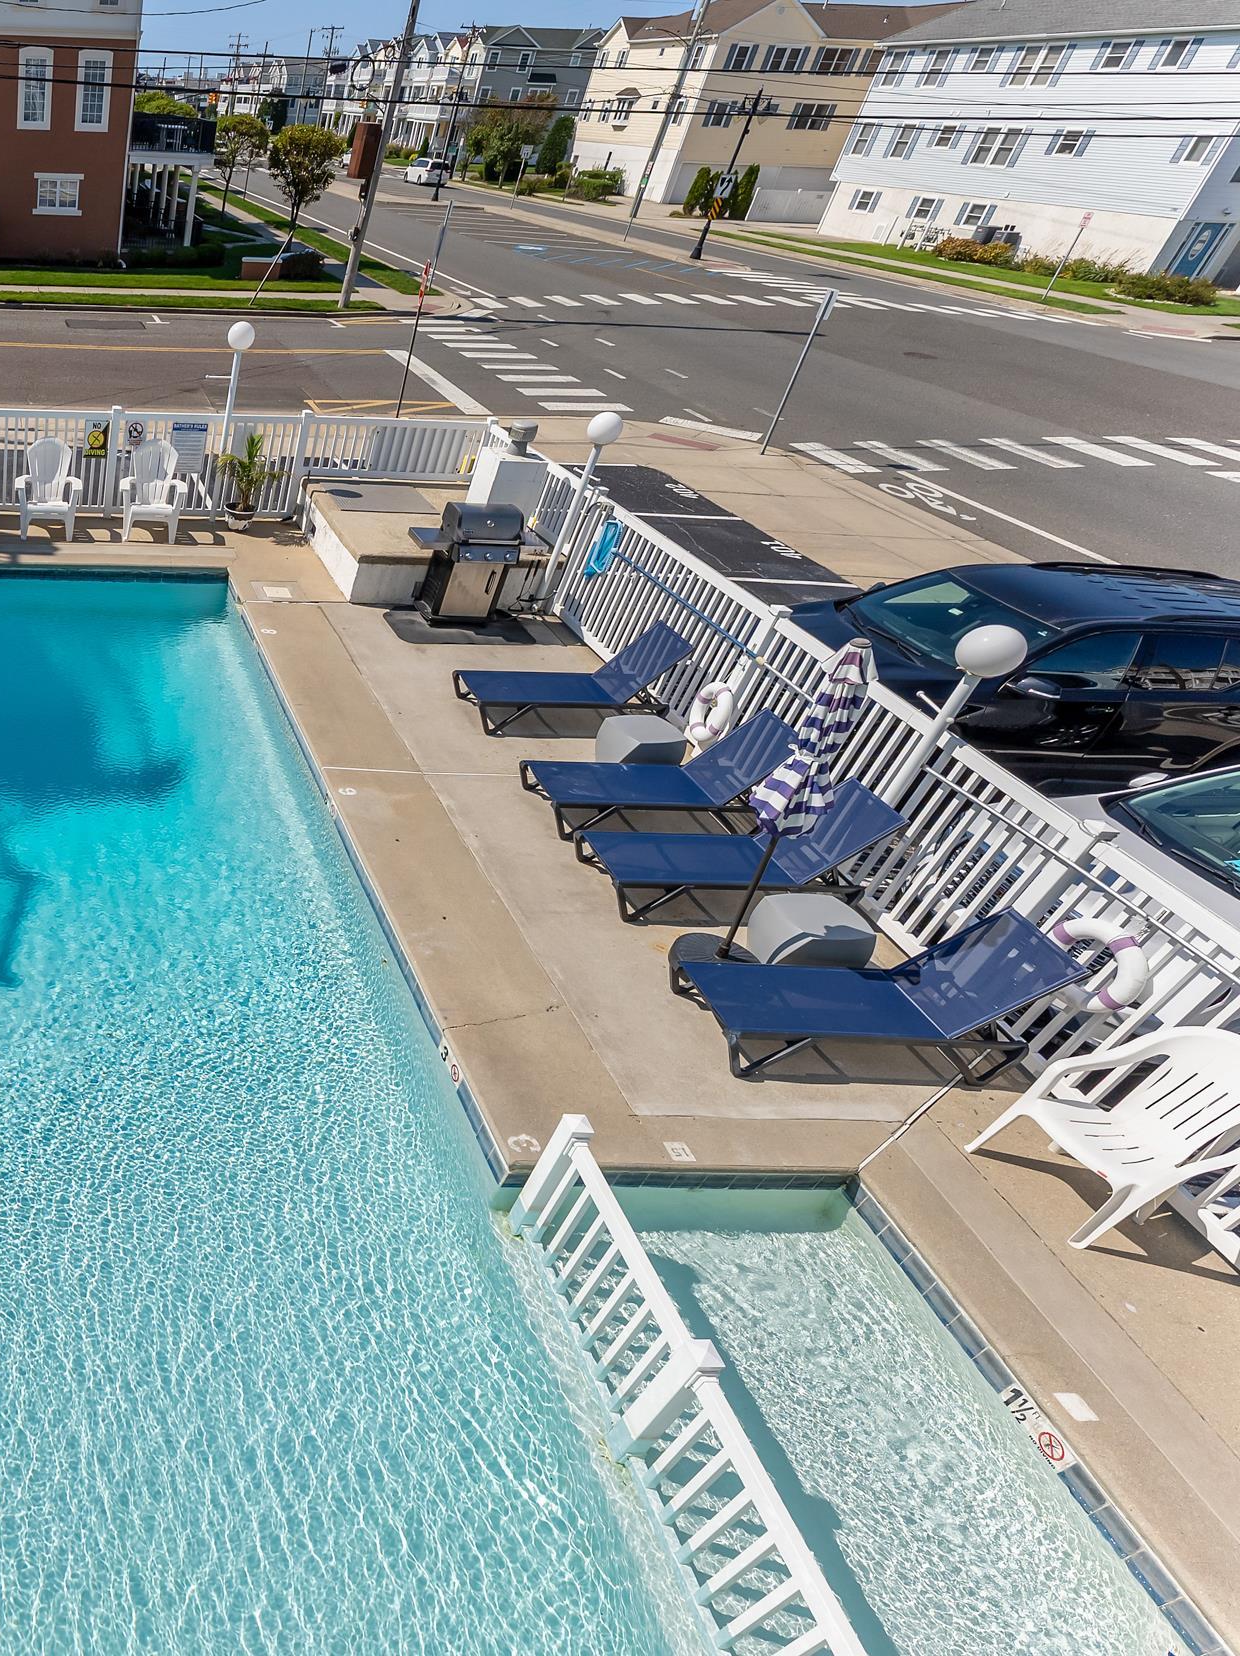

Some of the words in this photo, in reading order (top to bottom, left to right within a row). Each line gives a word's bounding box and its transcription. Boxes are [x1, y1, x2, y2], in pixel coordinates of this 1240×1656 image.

[664, 483, 700, 499] 402
[760, 540, 802, 560] 401
[441, 1046, 449, 1062] 3
